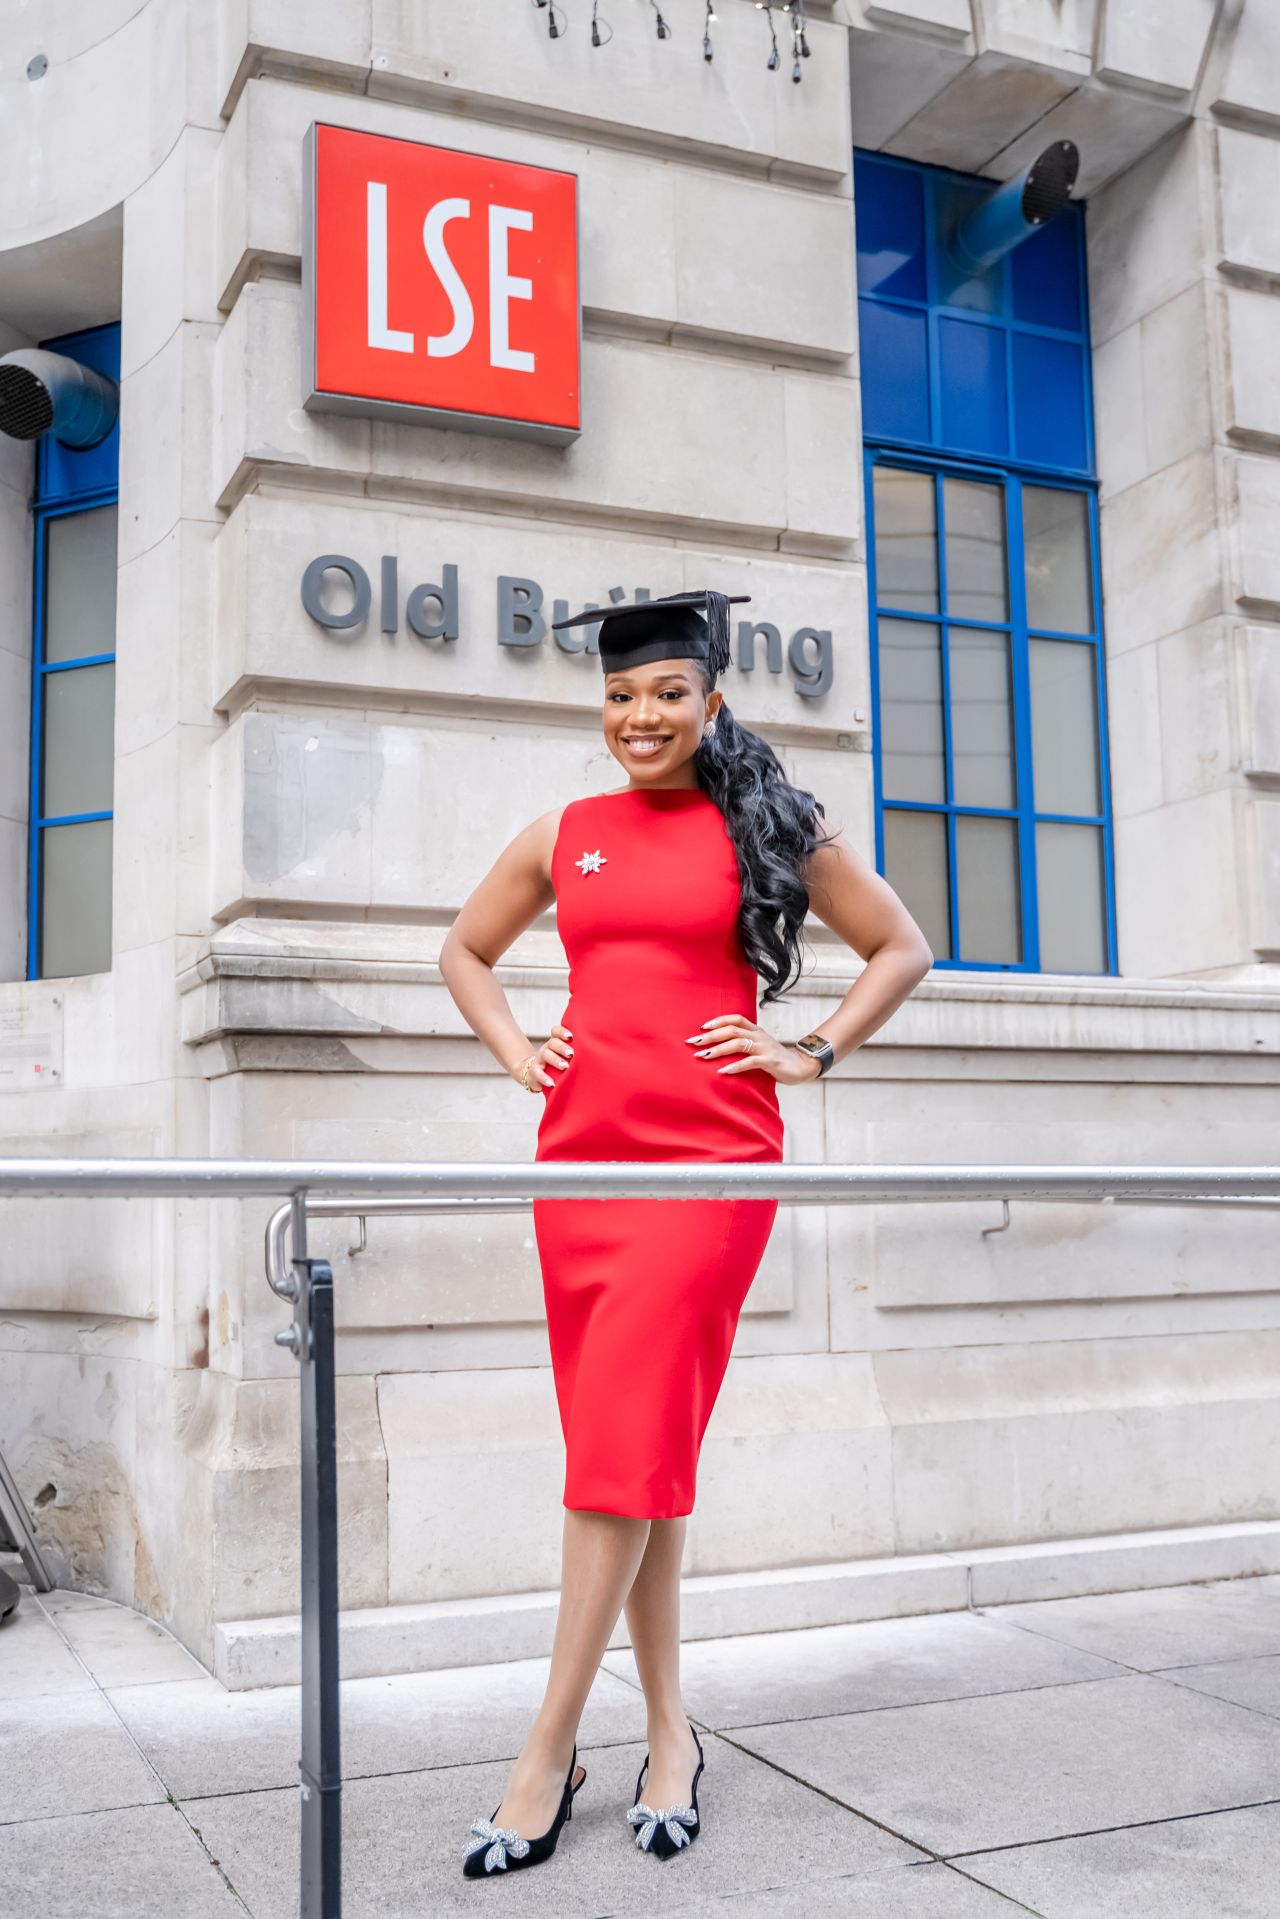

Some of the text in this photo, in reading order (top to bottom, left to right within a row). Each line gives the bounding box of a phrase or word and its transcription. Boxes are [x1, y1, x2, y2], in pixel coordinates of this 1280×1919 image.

[367, 181, 535, 373] LSE
[301, 554, 833, 697] Old Bung
